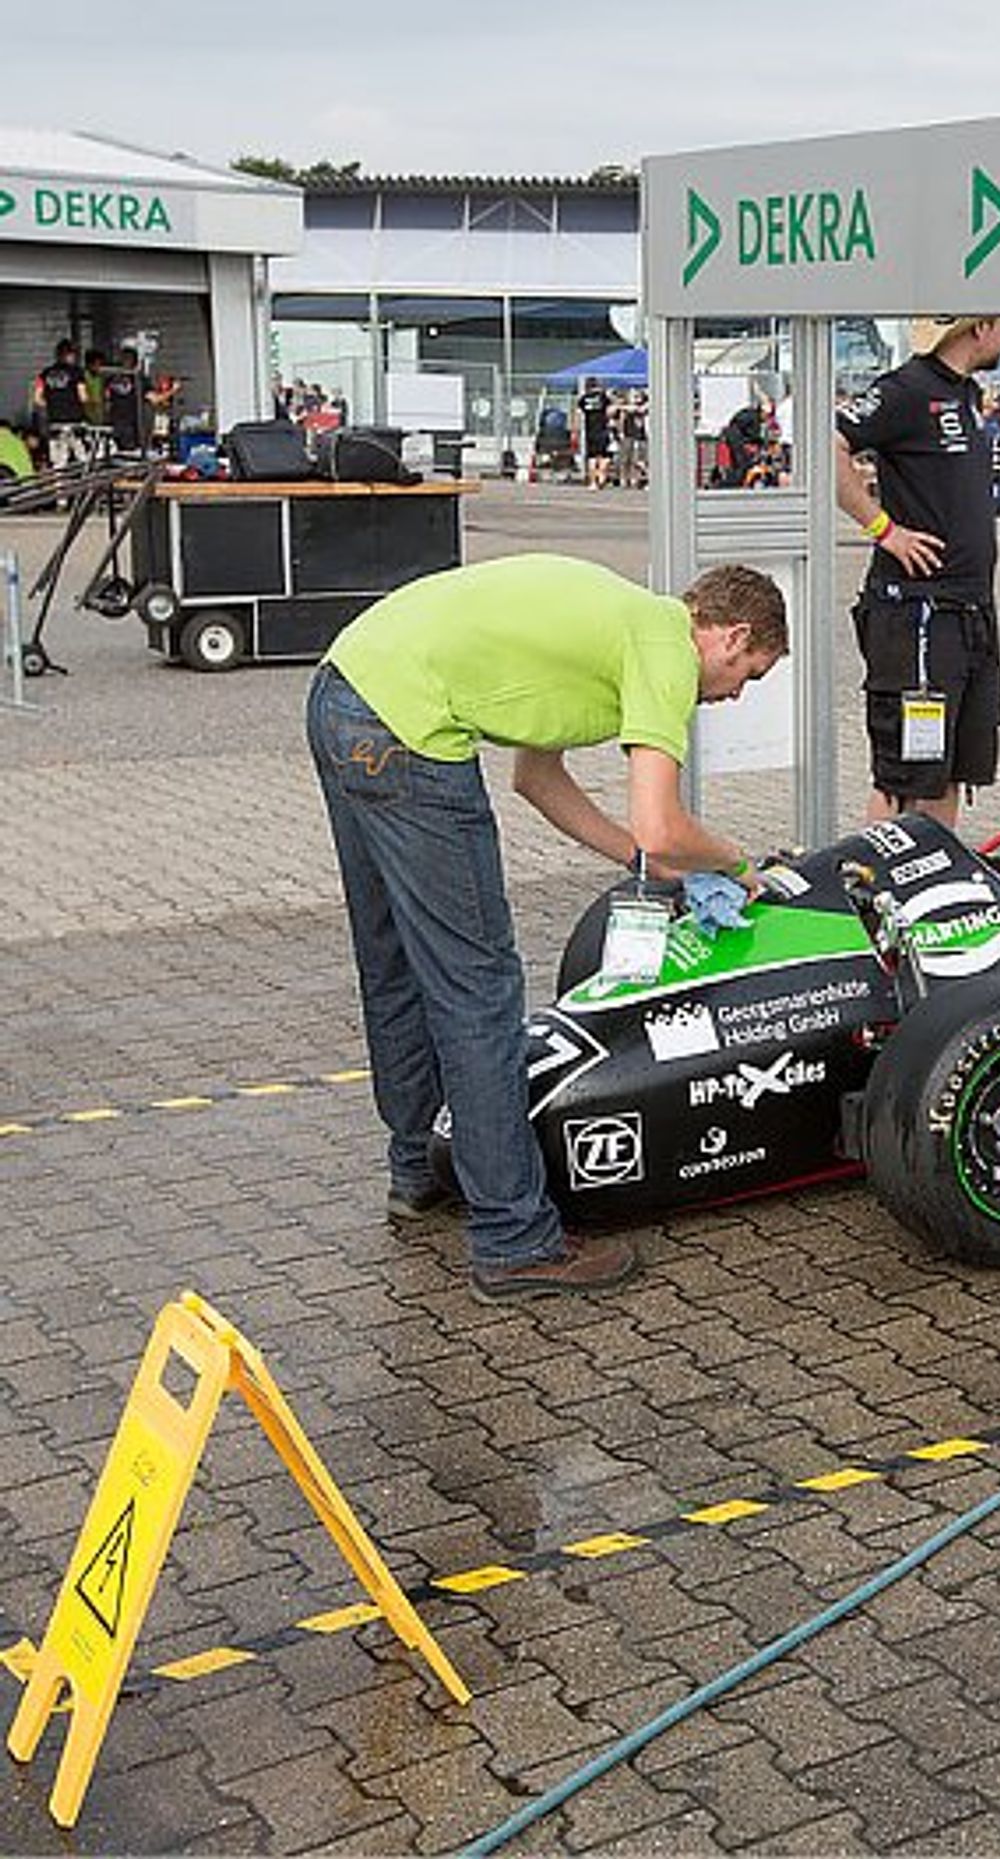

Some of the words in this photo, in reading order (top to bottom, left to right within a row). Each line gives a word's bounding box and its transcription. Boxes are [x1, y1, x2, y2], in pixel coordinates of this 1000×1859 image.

[34, 190, 169, 229] DEKRA
[738, 191, 875, 265] DEKRA
[724, 1020, 786, 1047] Holding
[788, 1009, 840, 1034] GmbH
[577, 1129, 632, 1171] ZF
